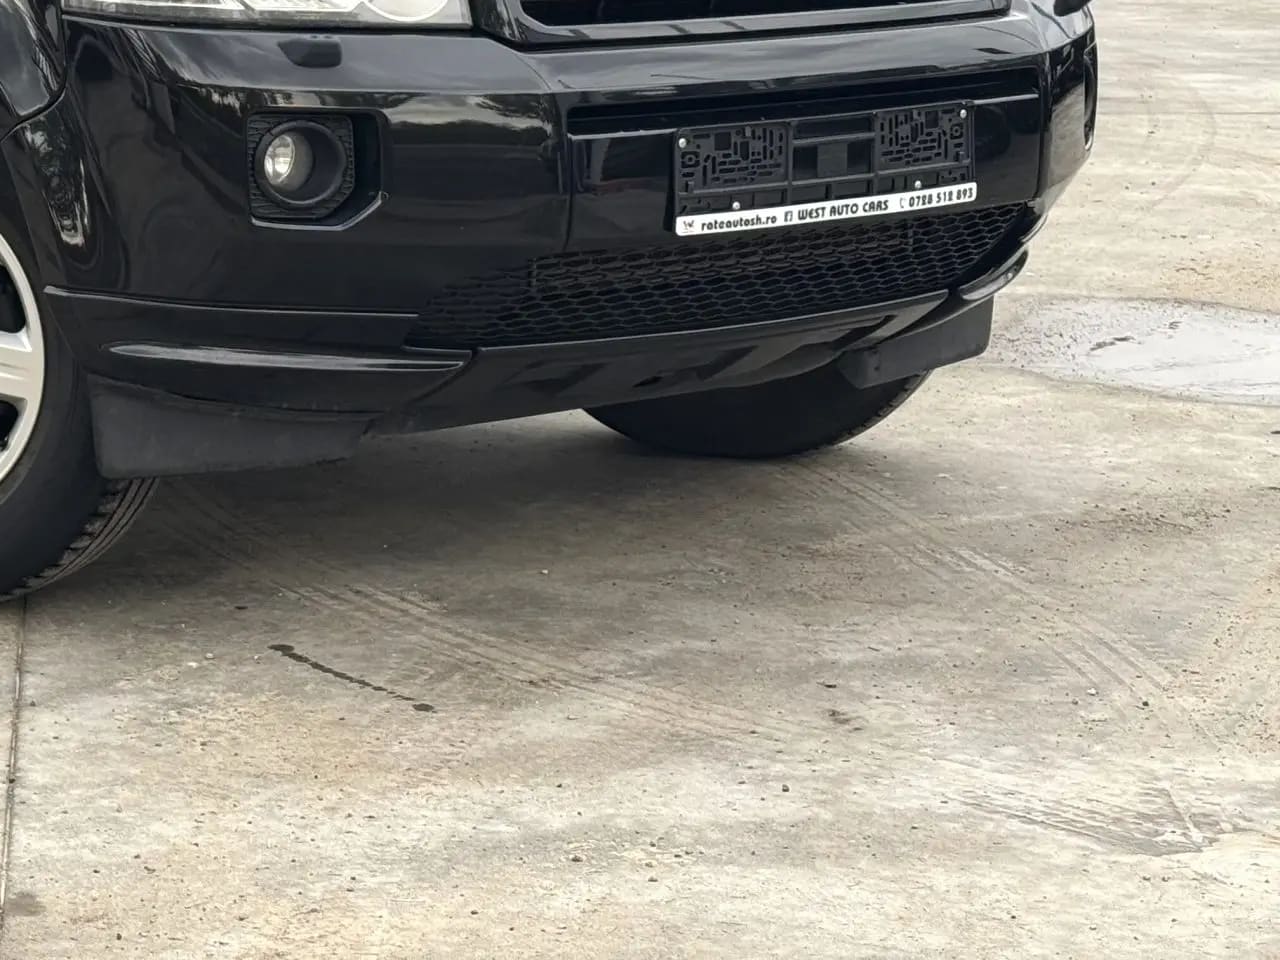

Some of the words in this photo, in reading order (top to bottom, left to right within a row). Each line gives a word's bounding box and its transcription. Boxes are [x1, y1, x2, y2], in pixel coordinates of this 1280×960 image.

[797, 206, 827, 221] WEST
[829, 202, 859, 217] AUTO
[862, 199, 889, 213] CARS
[908, 193, 933, 208] 0728
[936, 190, 953, 204] 512
[956, 187, 973, 201] 893
